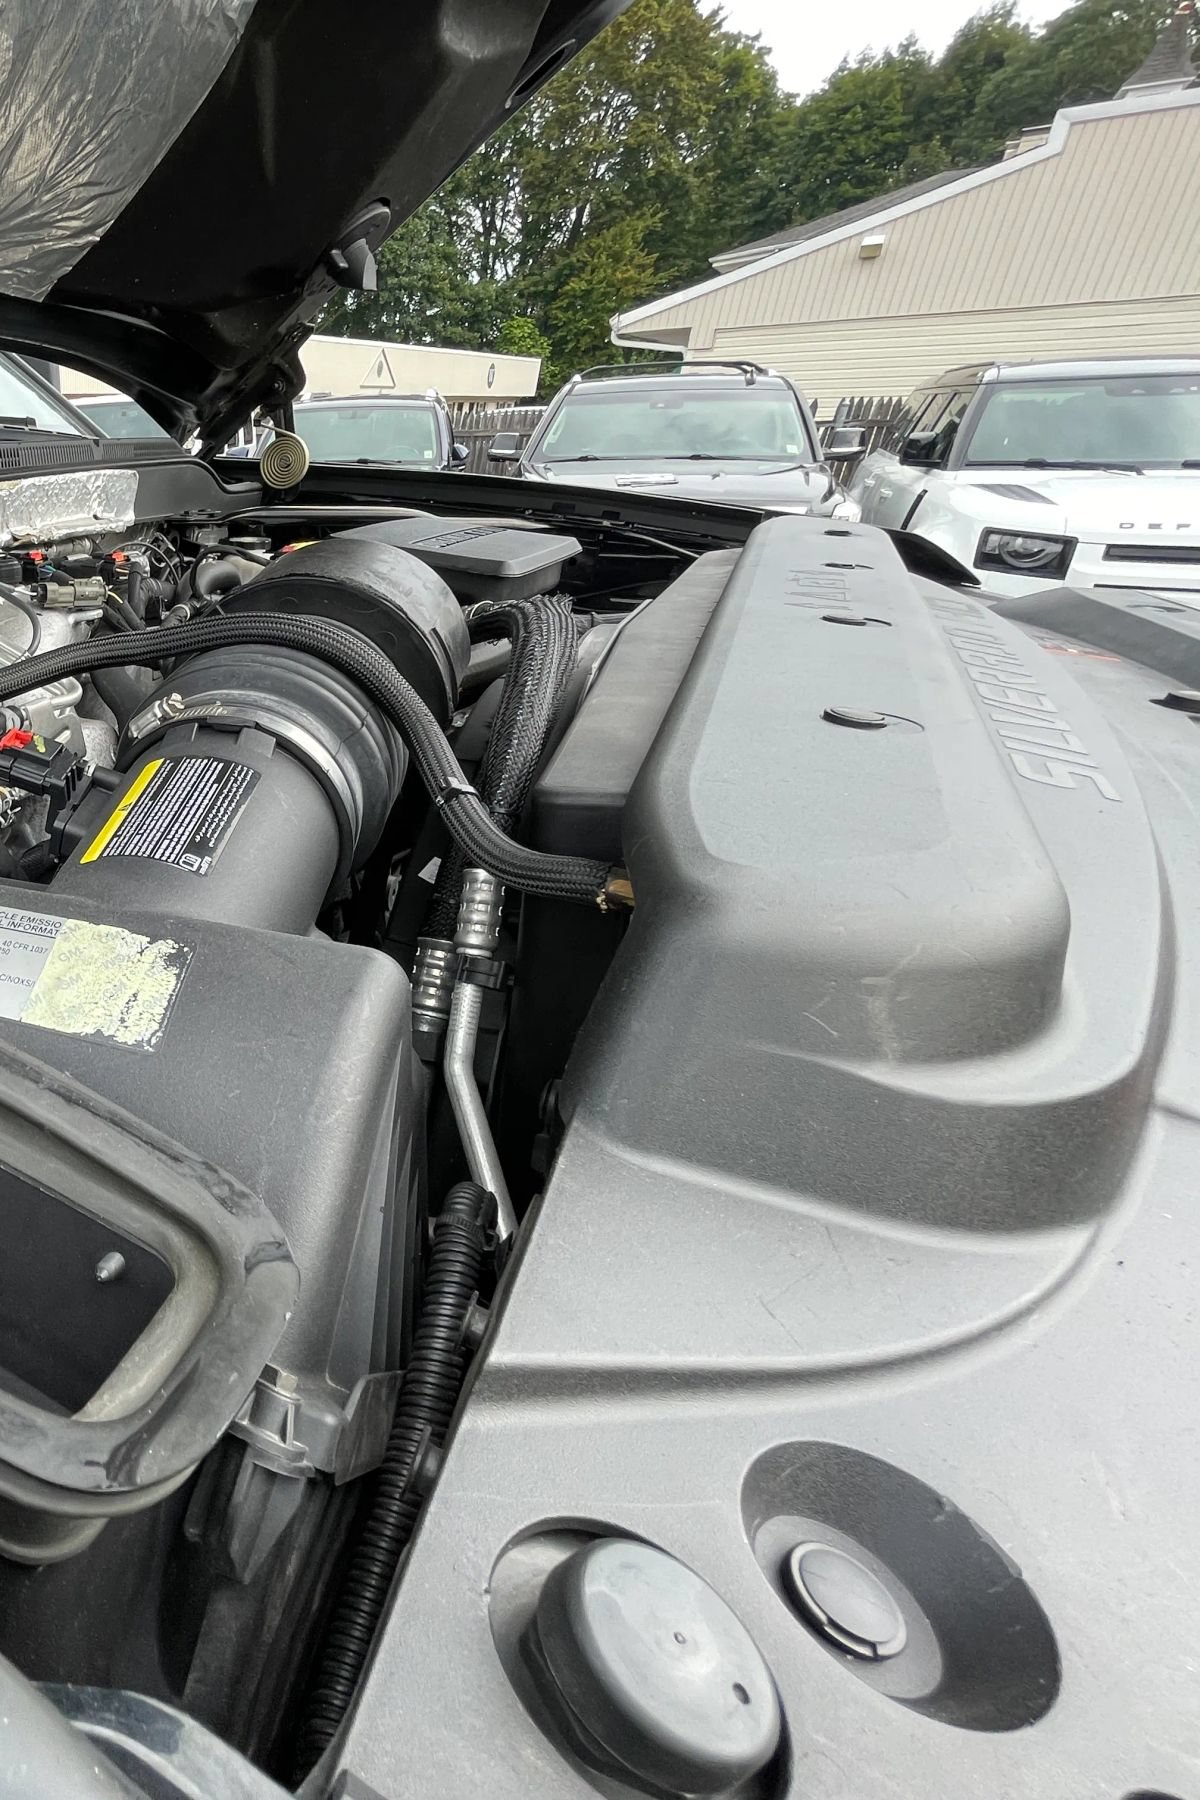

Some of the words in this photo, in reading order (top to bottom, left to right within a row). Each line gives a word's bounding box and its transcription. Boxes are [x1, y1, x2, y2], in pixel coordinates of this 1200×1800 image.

[942, 625, 1124, 803] SILVERADO
[2, 939, 12, 948] 40
[12, 941, 30, 952] CFR
[30, 945, 48, 955] 1037
